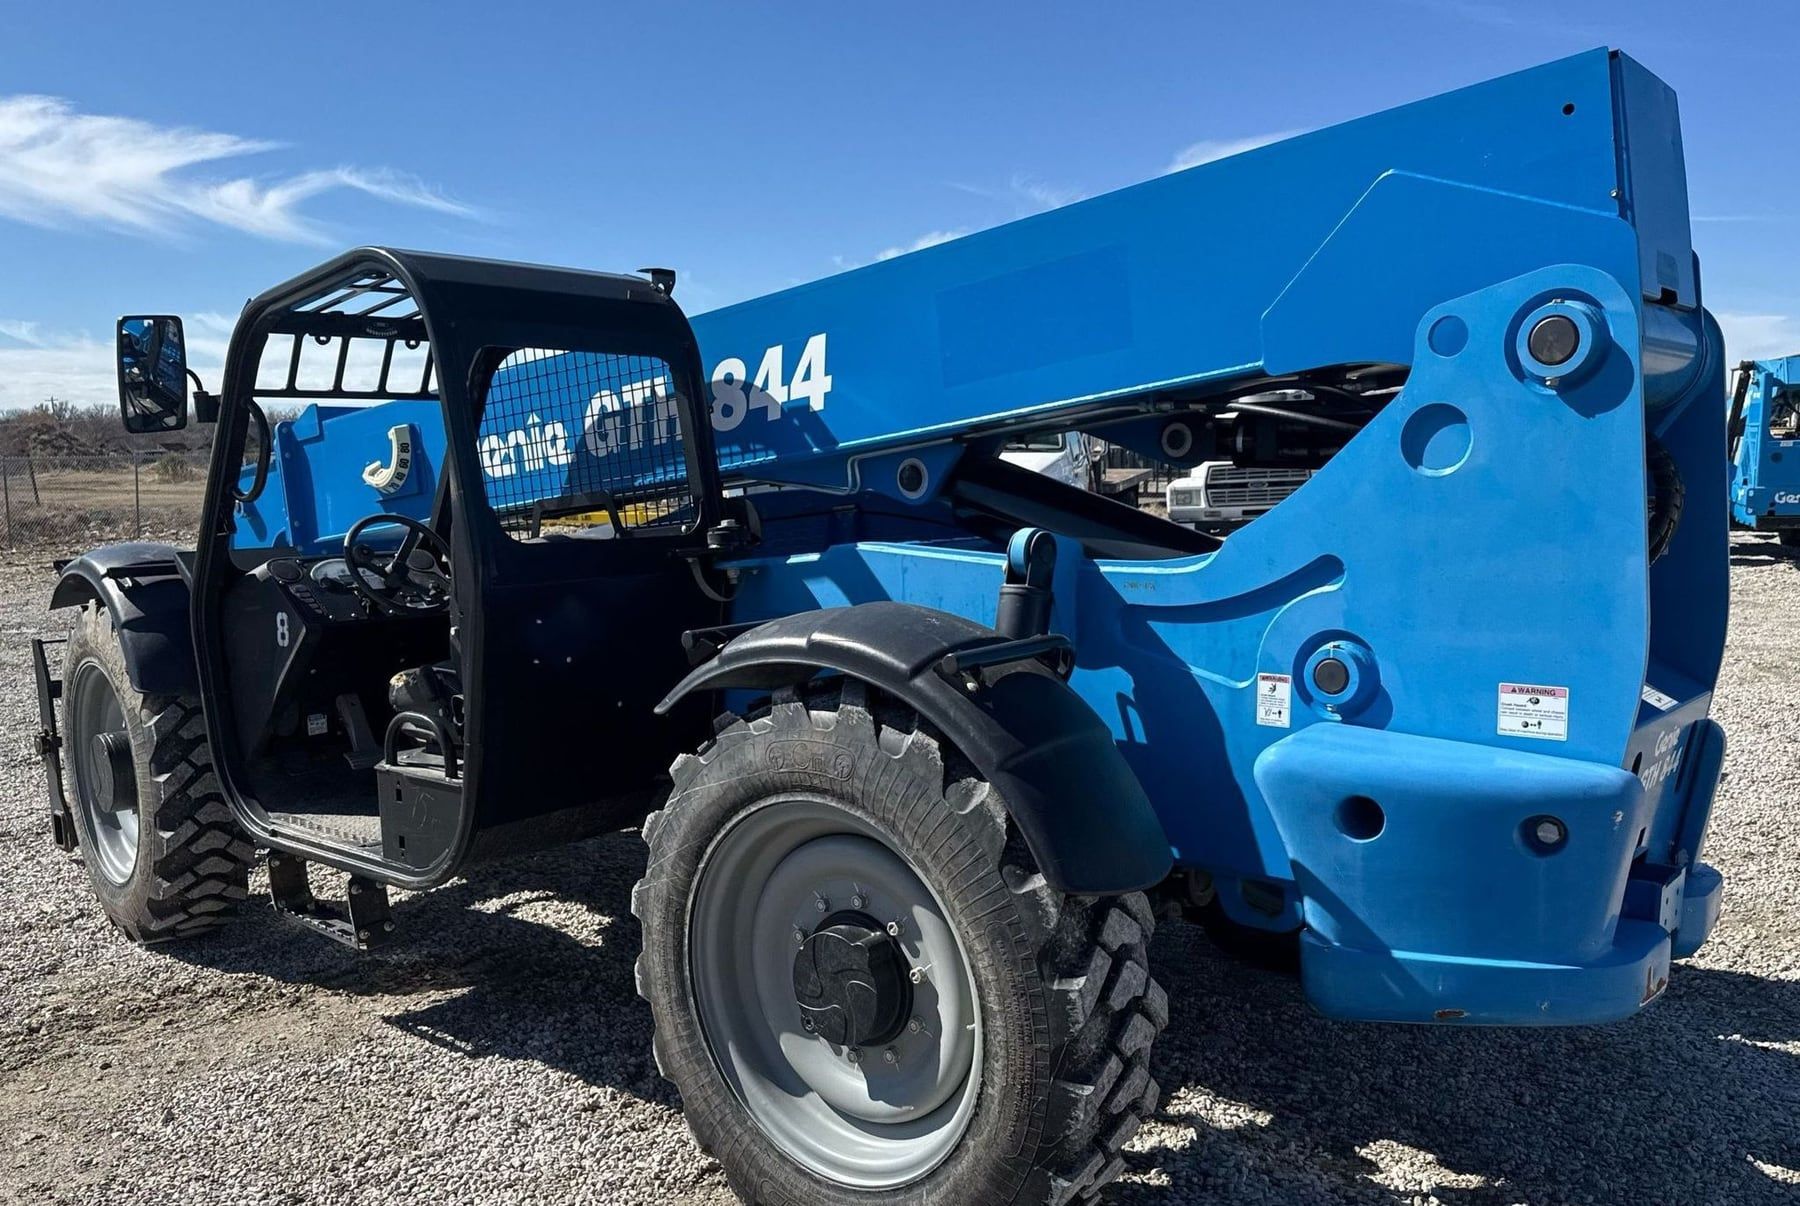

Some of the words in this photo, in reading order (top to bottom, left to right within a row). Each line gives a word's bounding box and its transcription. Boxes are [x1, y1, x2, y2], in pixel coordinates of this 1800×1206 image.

[711, 332, 832, 432] 844
[276, 611, 290, 648] 8
[1517, 686, 1556, 697] WARNING
